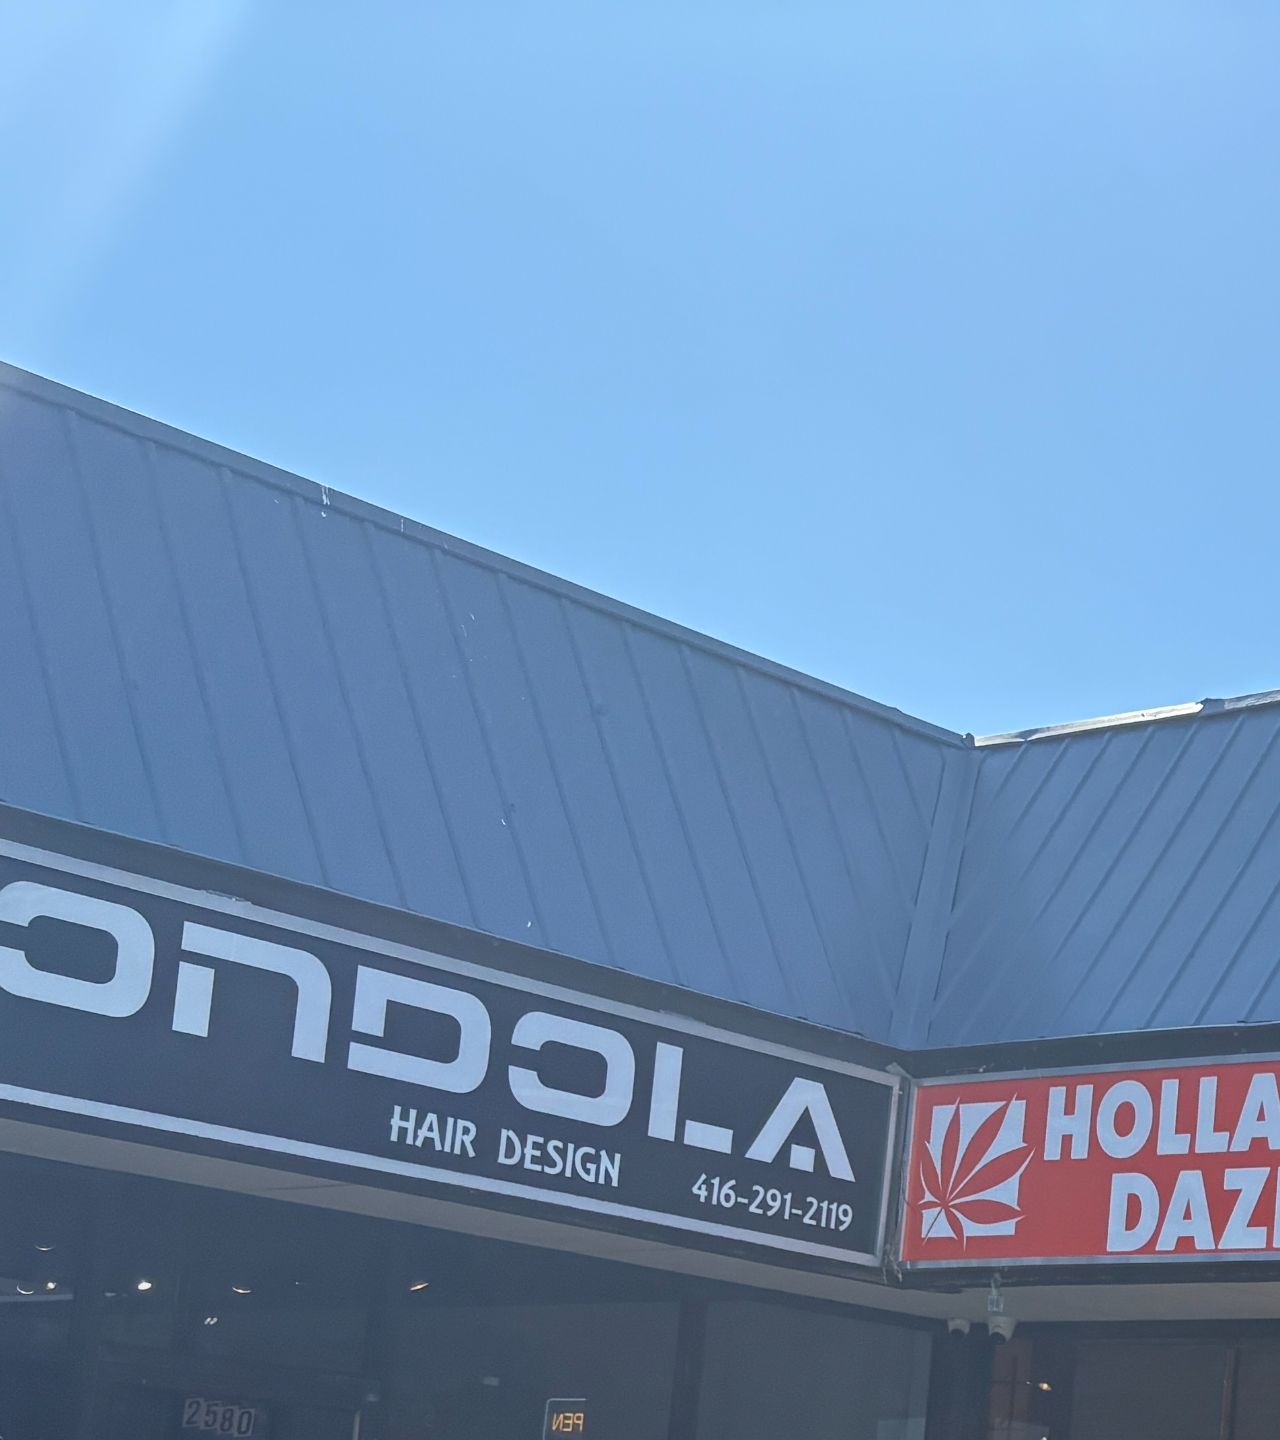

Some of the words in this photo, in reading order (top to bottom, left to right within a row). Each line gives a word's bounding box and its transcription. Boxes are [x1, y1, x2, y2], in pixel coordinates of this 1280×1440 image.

[390, 1105, 477, 1158] HAIR
[497, 1128, 621, 1188] DESIGN
[691, 1172, 855, 1232] 416-291-2119
[185, 1400, 251, 1435] 2580
